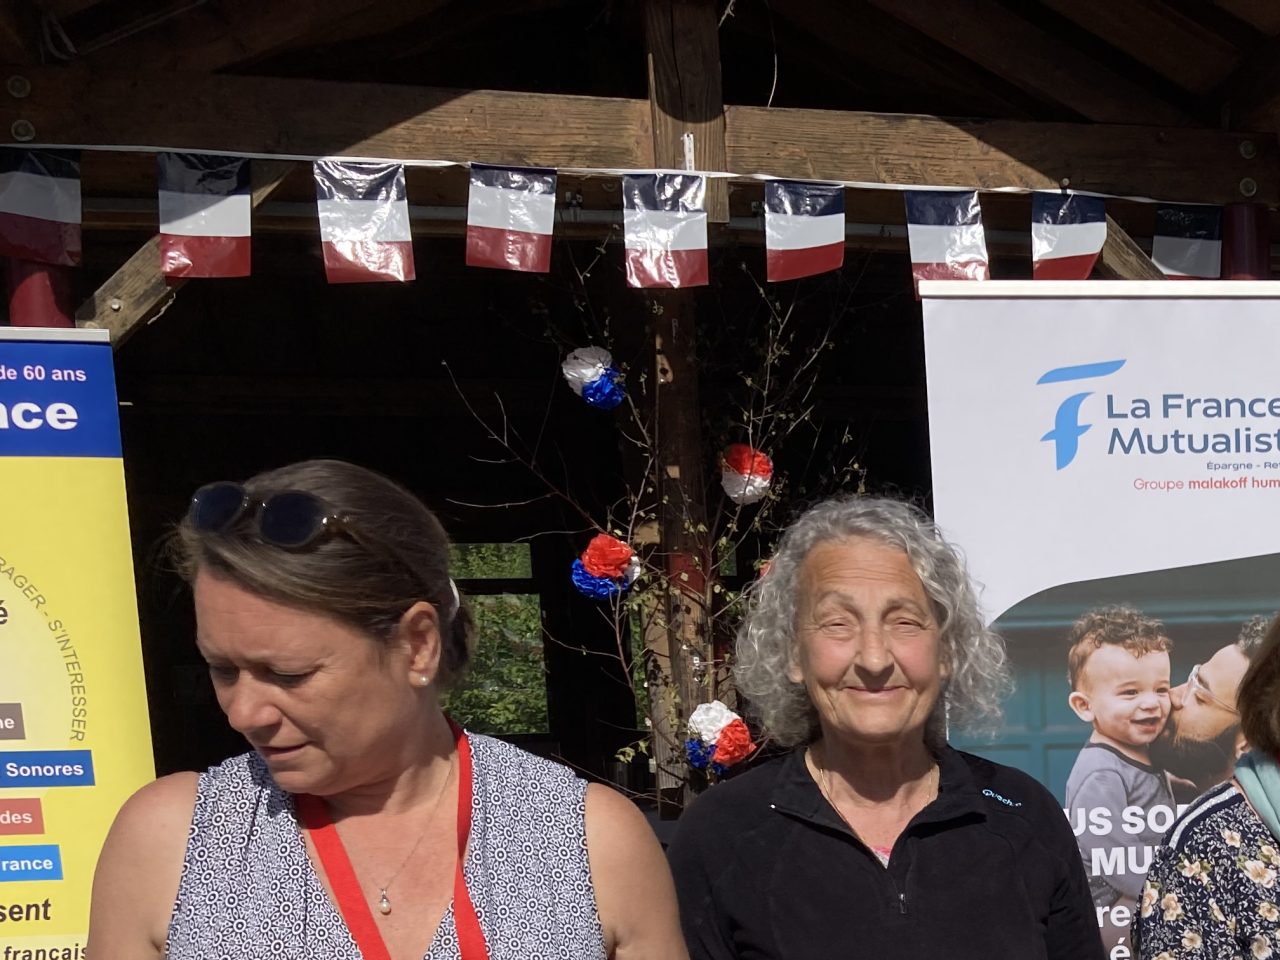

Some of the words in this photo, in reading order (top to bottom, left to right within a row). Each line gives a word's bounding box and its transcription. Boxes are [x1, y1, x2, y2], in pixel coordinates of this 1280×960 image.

[23, 365, 45, 381] 60
[51, 368, 87, 381] ans
[1107, 394, 1150, 419] La
[1206, 461, 1253, 471] Épargne
[1133, 478, 1184, 492] Groupe
[1188, 477, 1248, 489] malakoff
[48, 619, 87, 741] S'INTERESSER
[6, 762, 84, 777] Sonores
